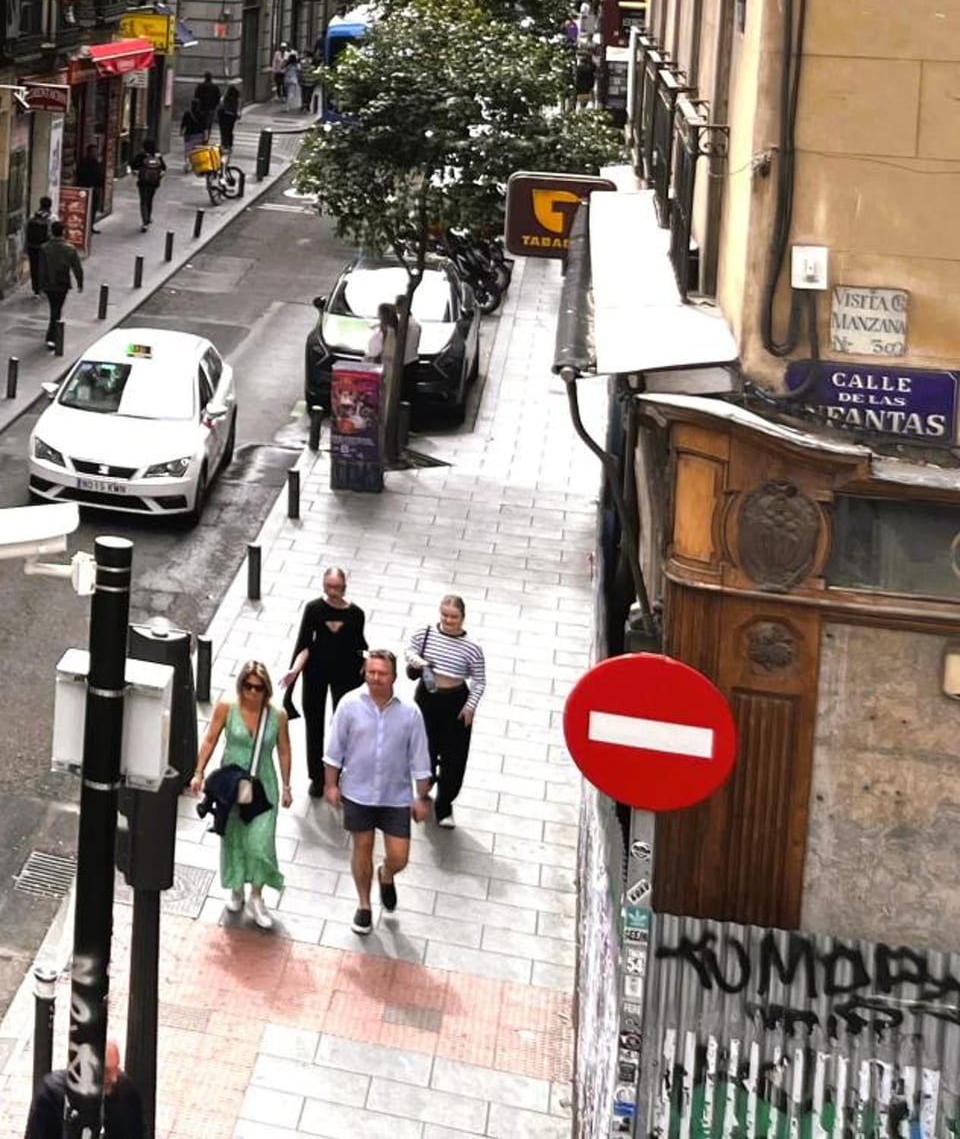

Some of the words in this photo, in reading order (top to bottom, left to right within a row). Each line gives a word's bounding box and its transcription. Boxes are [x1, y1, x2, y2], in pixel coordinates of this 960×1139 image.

[831, 371, 912, 393] CALLE
[838, 392, 865, 404] DE
[868, 394, 907, 407] LAS
